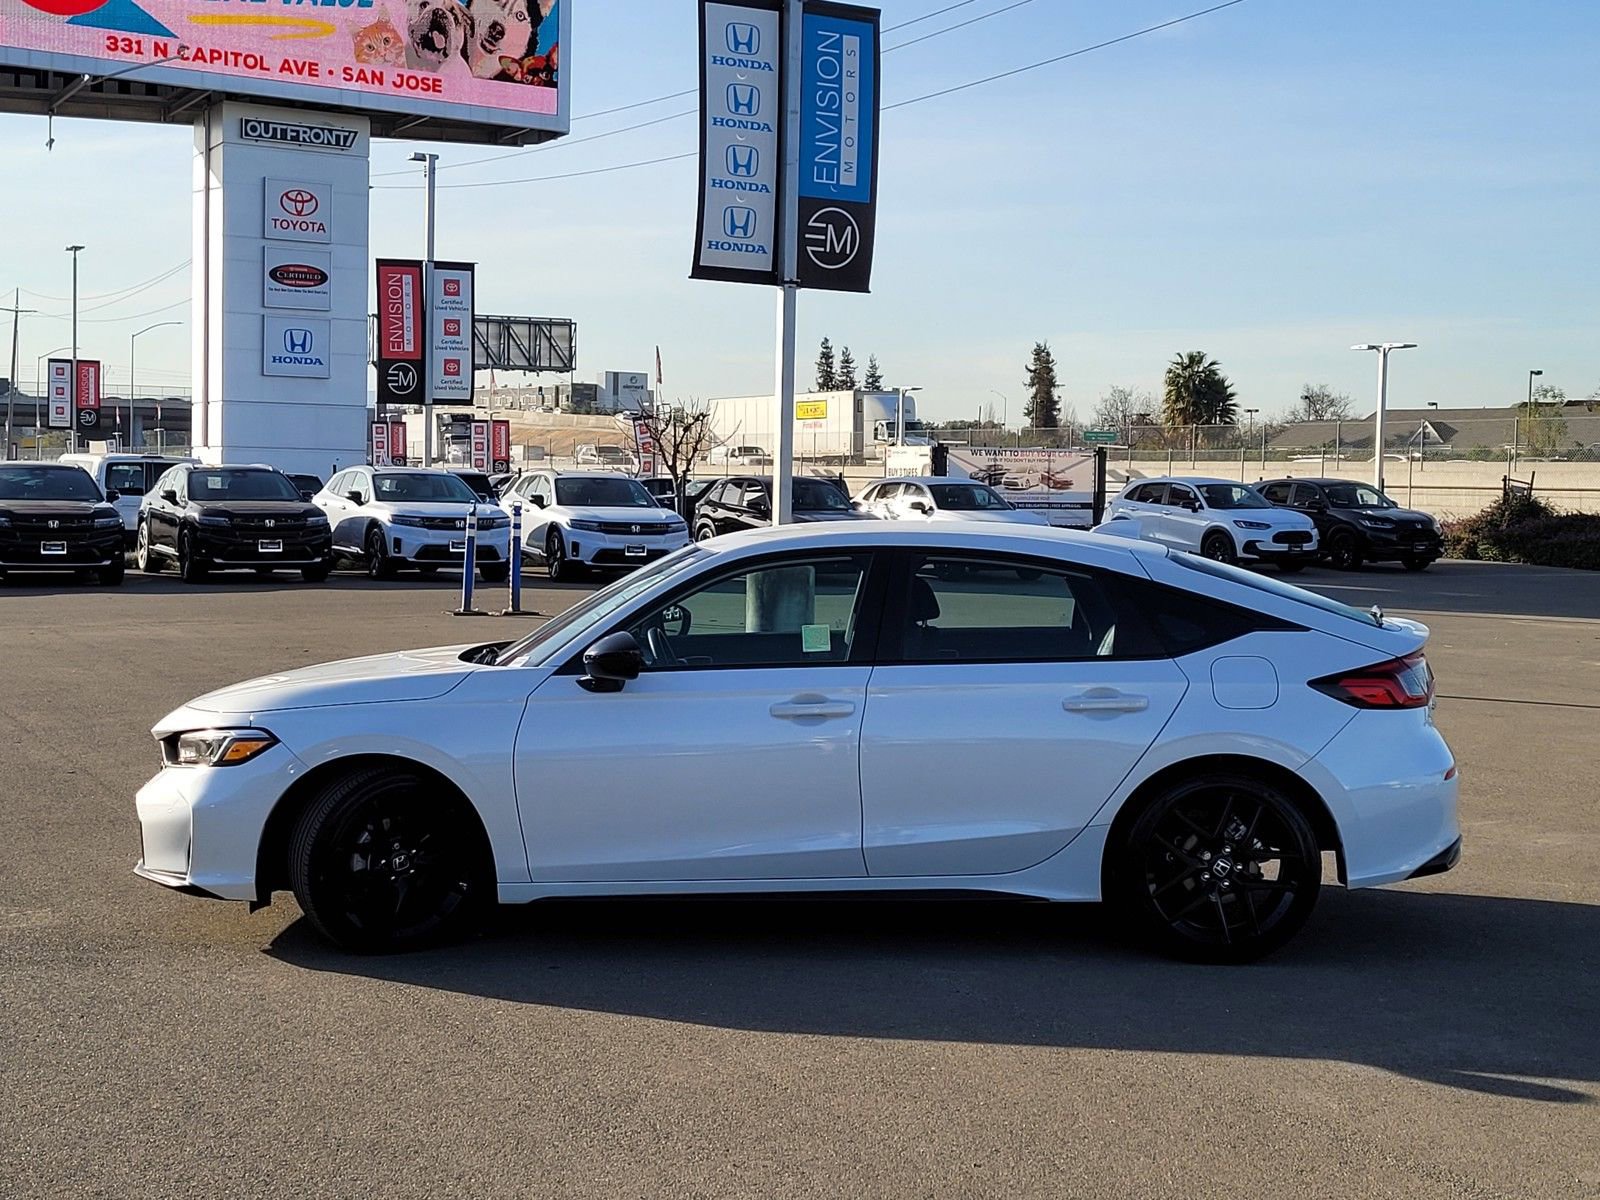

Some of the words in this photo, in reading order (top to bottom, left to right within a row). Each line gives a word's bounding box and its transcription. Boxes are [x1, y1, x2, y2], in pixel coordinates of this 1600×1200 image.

[106, 35, 144, 56] 331
[154, 41, 168, 58] N
[177, 44, 270, 72] CAPITOL
[279, 58, 320, 78] AVE
[342, 66, 384, 86] SAN
[392, 74, 442, 94] JOSE
[712, 56, 774, 72] HONDA
[814, 30, 841, 184] ENVISION
[844, 48, 856, 173] MOTORS
[712, 116, 774, 133] HONDA
[711, 178, 771, 194] HONDA
[272, 218, 326, 234] TOYOTA
[707, 240, 768, 255] HONDA
[388, 273, 404, 352] ENVISION
[272, 355, 324, 366] HONDA
